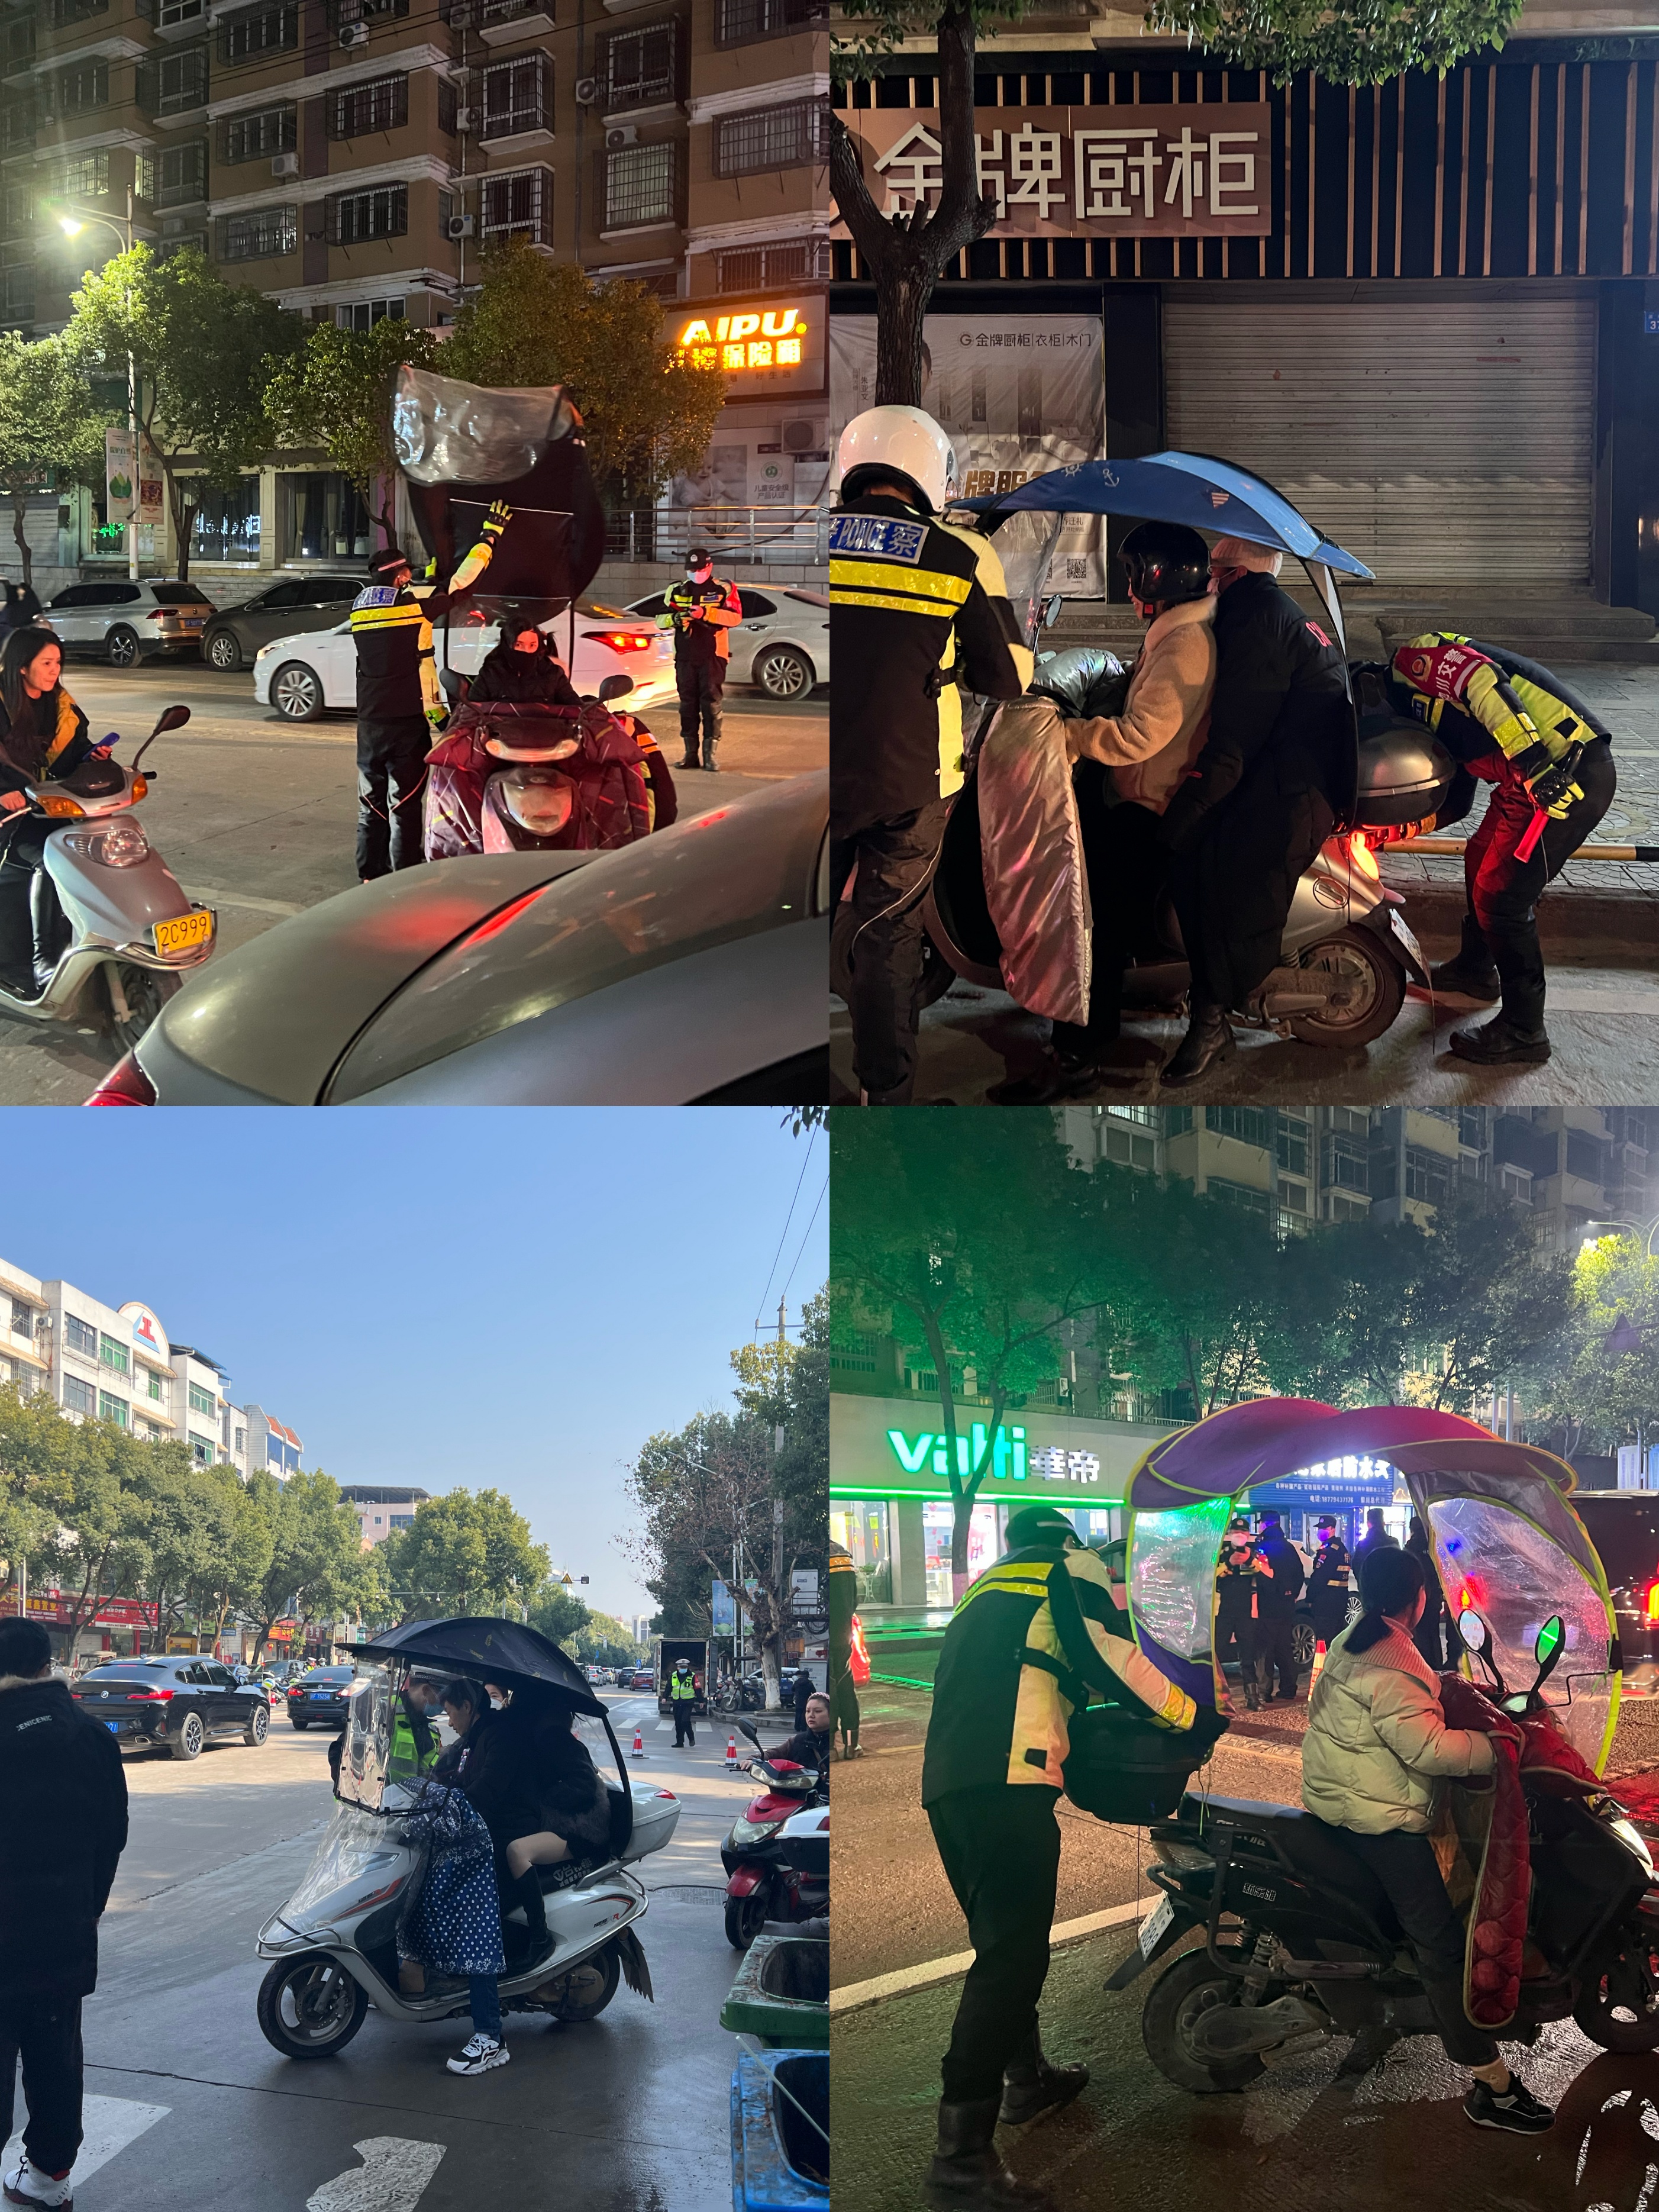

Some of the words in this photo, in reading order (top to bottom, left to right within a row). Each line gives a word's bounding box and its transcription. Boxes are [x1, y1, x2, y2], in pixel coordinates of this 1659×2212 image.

[873, 122, 1258, 219] 金牌厨柜
[663, 338, 802, 373] 保险箱
[958, 470, 1047, 498] 牌服
[837, 518, 890, 551] POLICE
[888, 525, 921, 557] 察
[160, 916, 207, 947] 2C999
[1028, 1446, 1100, 1484] 華帝
